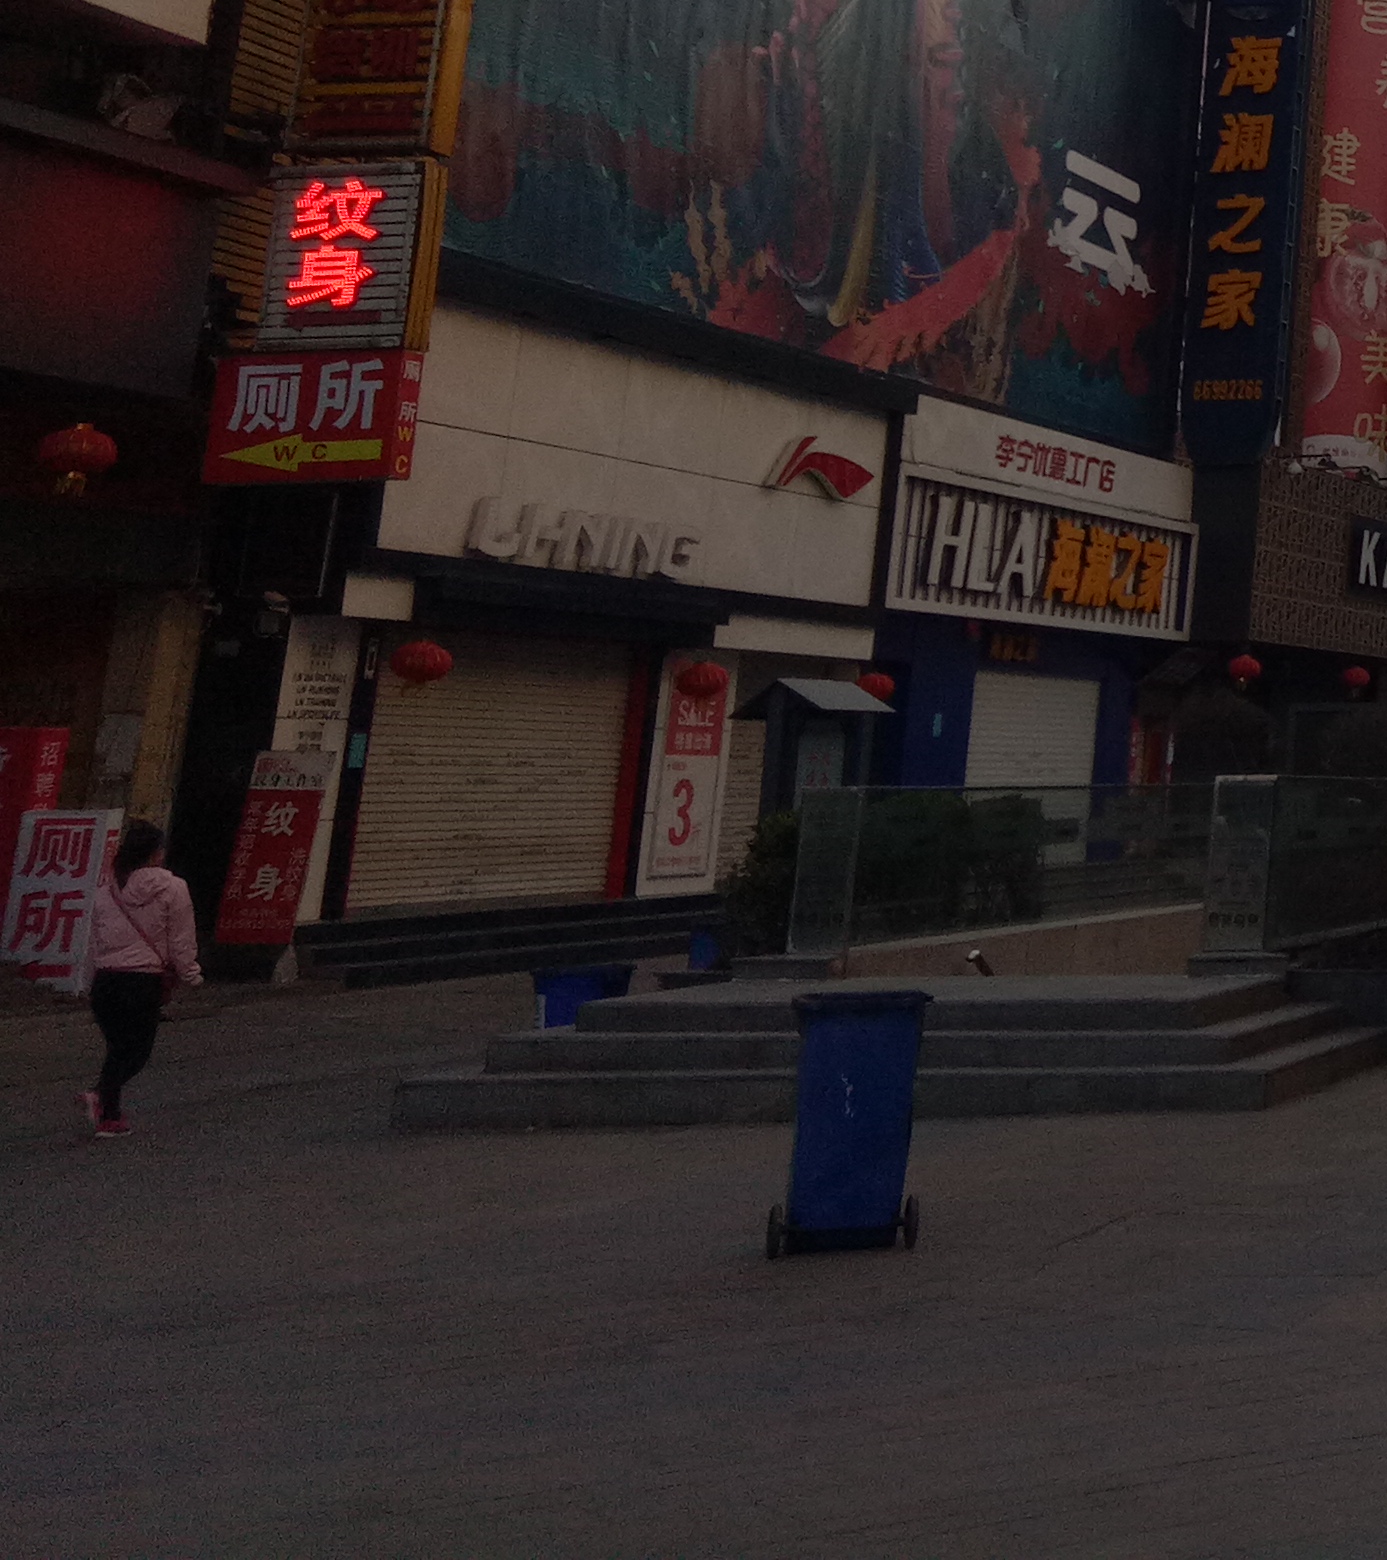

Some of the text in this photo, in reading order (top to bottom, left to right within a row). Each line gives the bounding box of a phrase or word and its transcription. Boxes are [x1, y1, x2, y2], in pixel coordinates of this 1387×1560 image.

[1201, 35, 1283, 330] 海澜之家
[287, 179, 384, 308] 纹身
[226, 357, 385, 433] 厕所
[995, 434, 1117, 493] 李宁优惠工厂店
[926, 492, 1169, 613] HLA 海澜之家
[246, 800, 300, 901] 纹身
[668, 777, 695, 847] 3
[9, 817, 98, 953] 厕所
